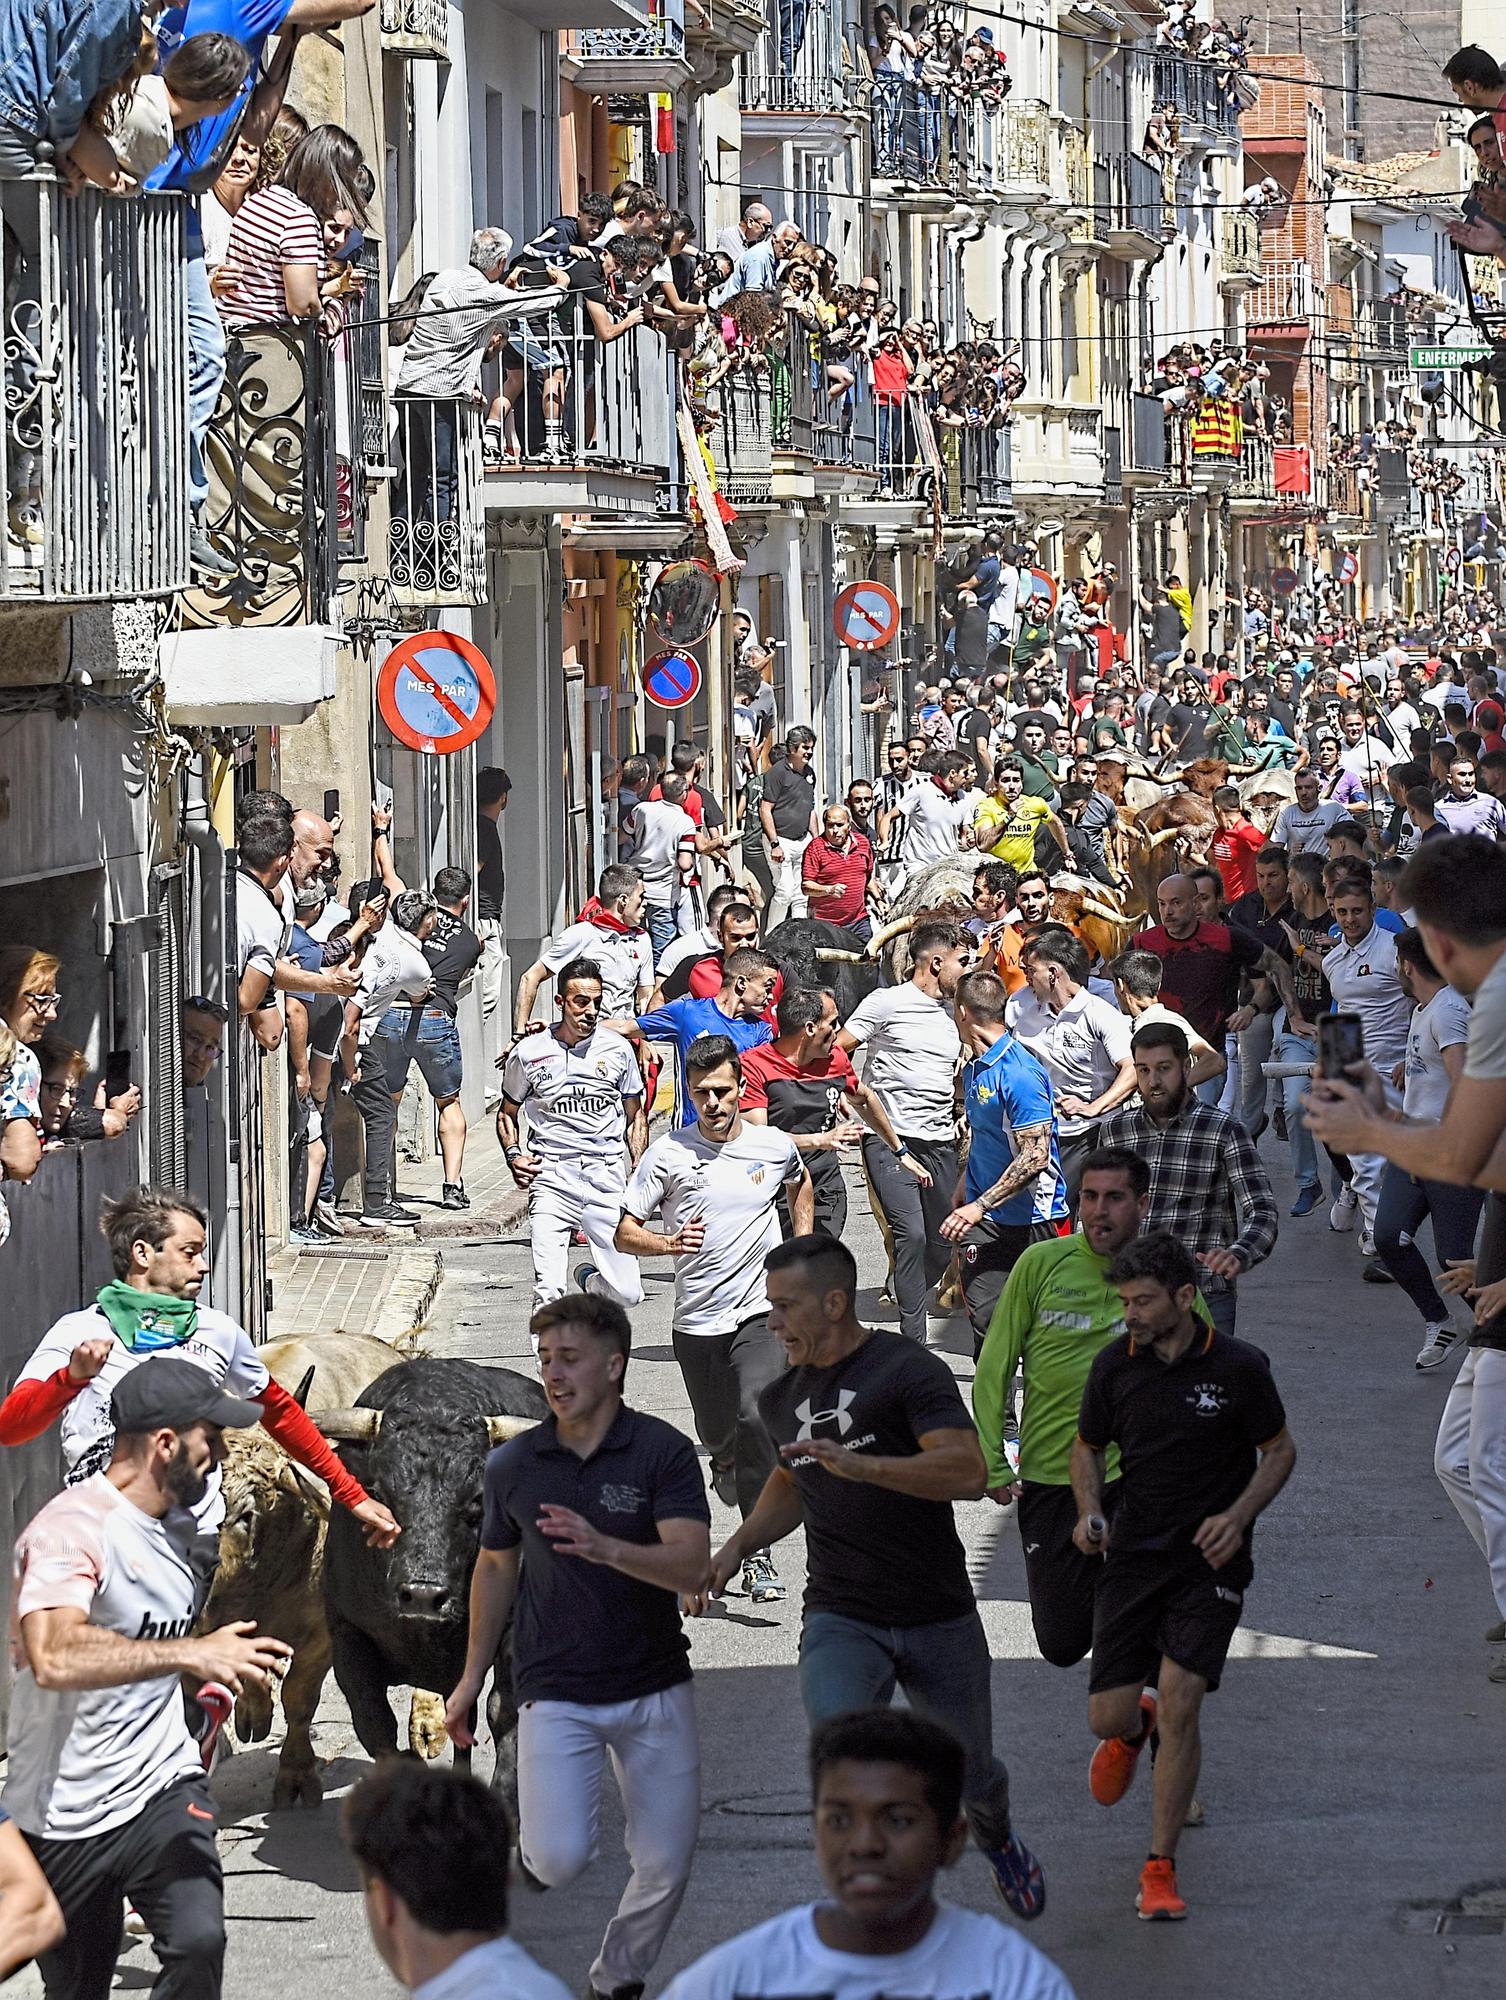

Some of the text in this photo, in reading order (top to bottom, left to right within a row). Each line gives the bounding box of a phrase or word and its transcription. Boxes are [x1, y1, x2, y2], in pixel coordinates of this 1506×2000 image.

[868, 610, 884, 619] PAR
[655, 651, 689, 662] MES PAR
[407, 680, 466, 697] MES PAR
